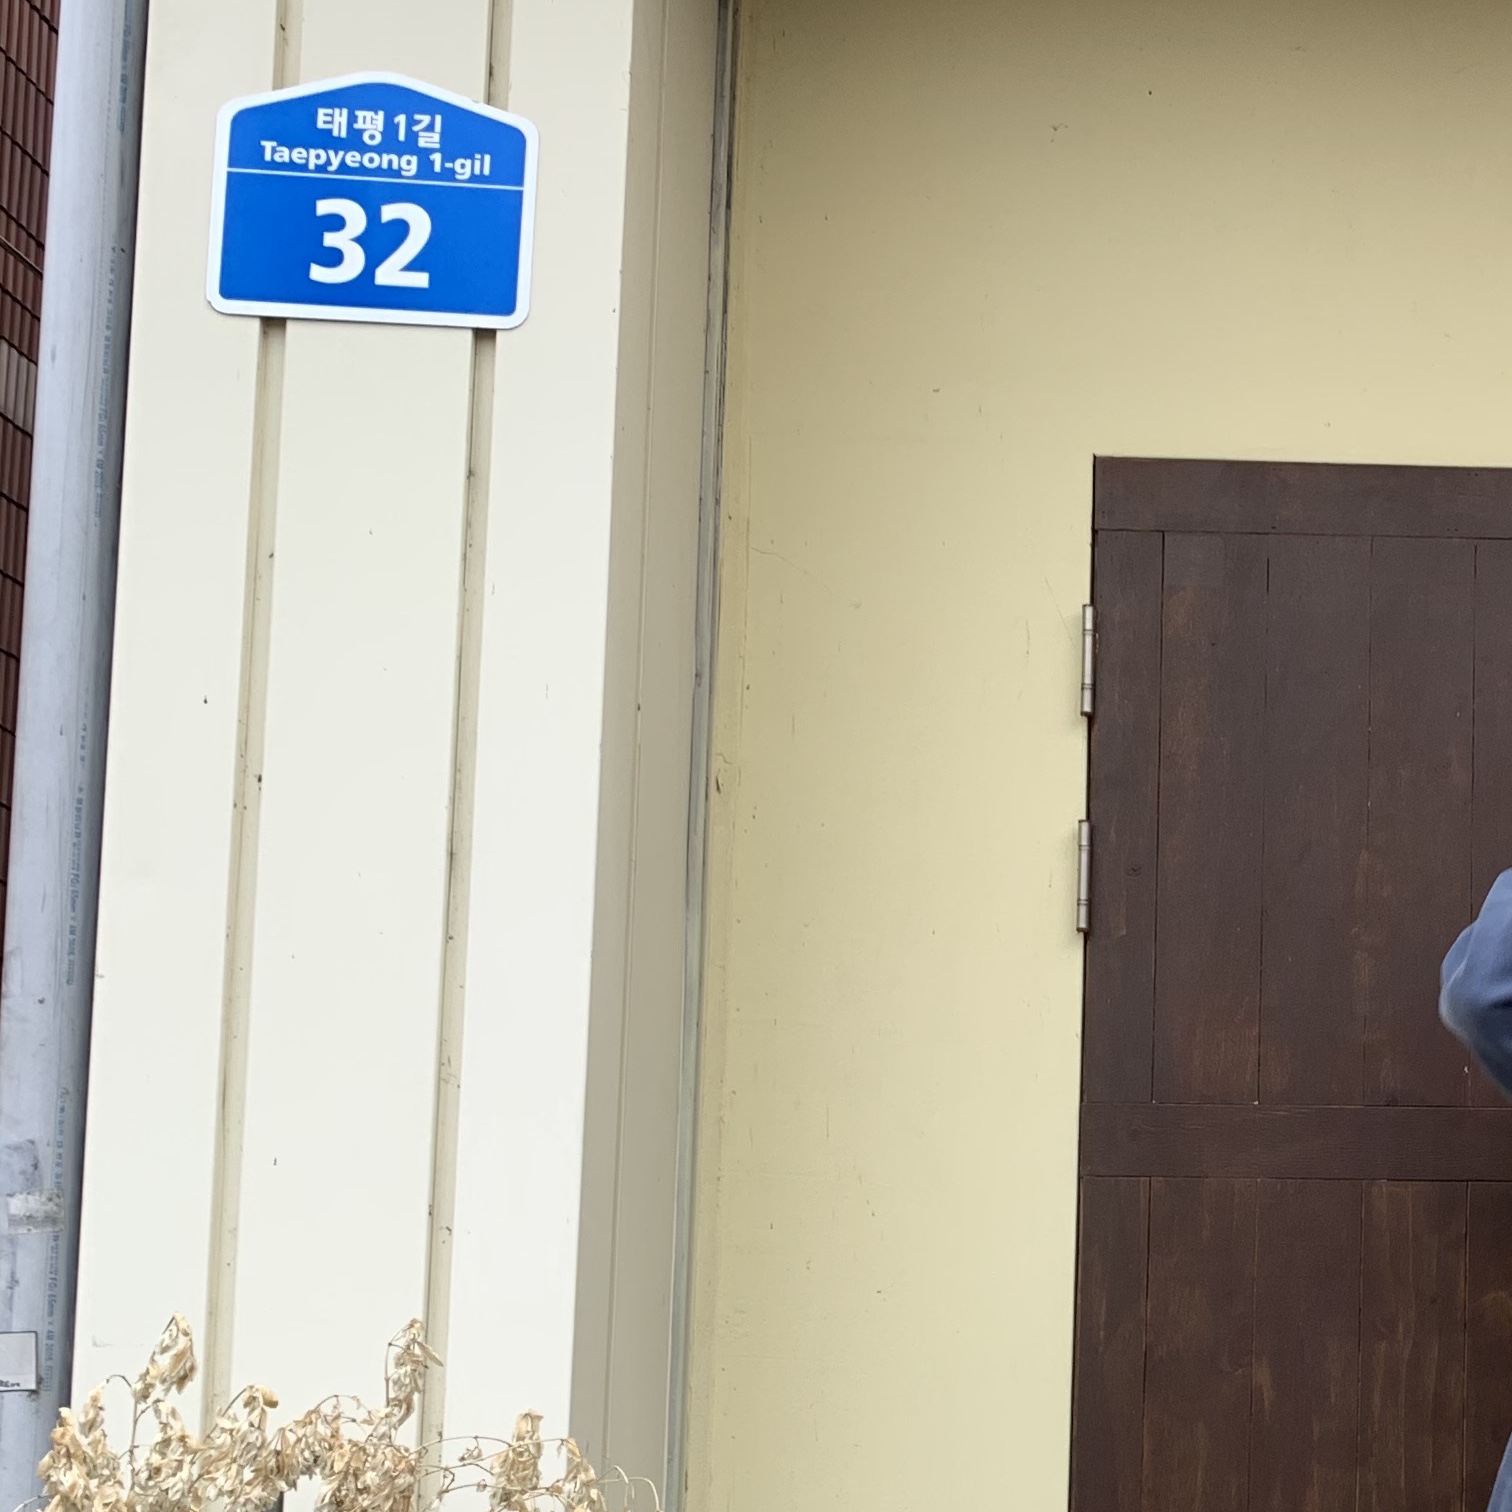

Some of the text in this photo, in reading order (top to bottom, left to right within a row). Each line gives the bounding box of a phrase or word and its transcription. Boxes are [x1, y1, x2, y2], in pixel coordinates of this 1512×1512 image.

[316, 107, 442, 149] 태평1길
[259, 140, 491, 181] Taepyeong 1-gil
[309, 197, 432, 289] 32
